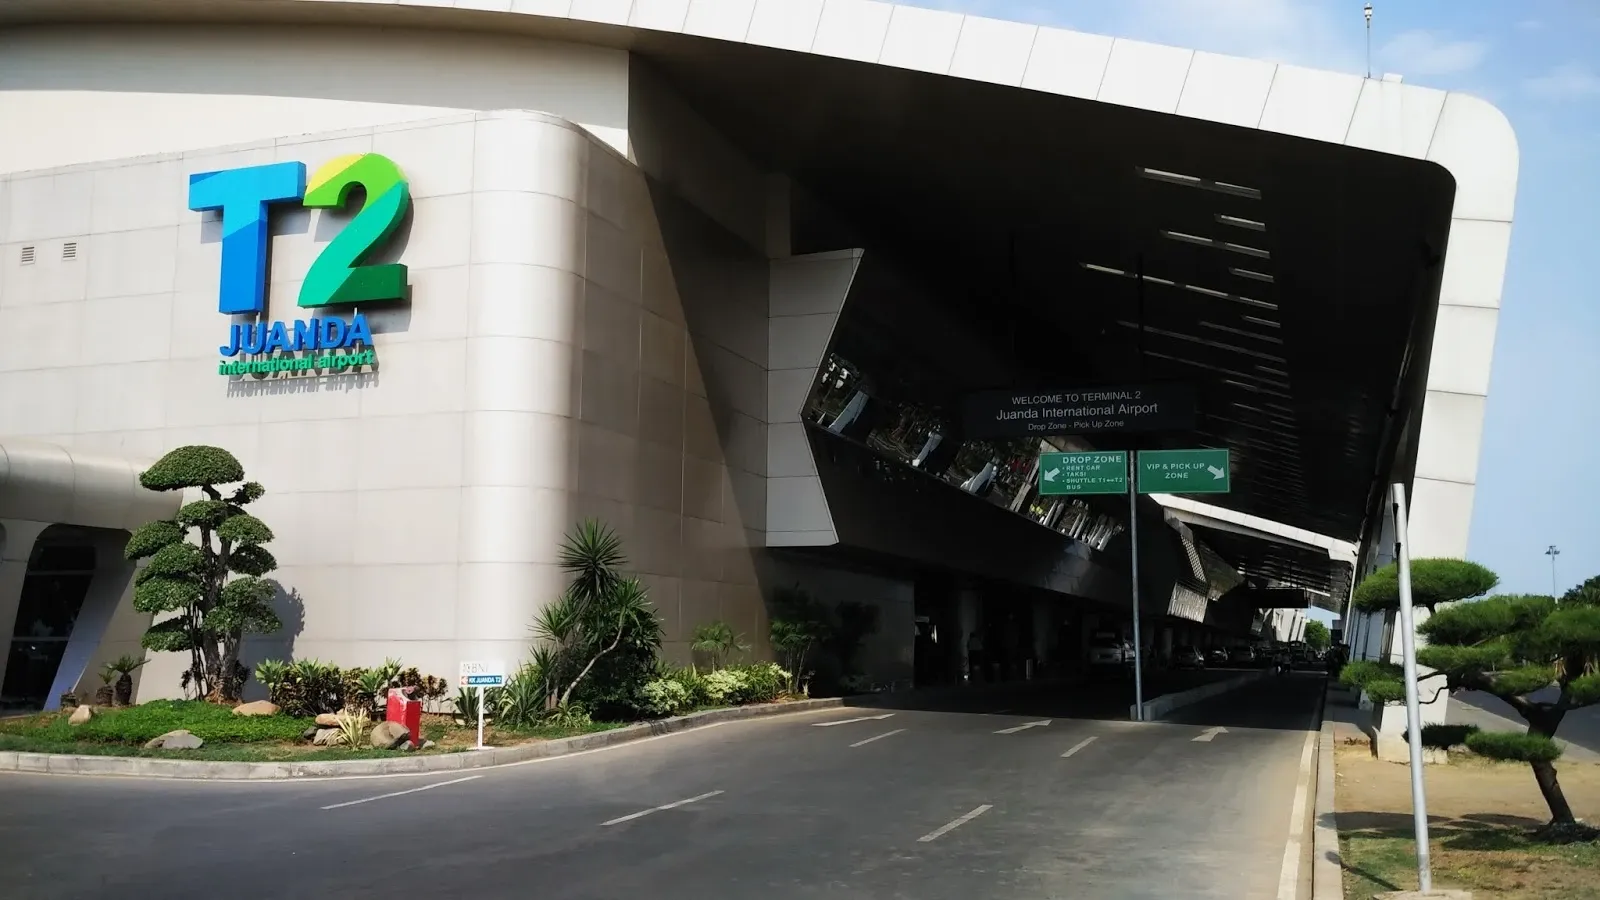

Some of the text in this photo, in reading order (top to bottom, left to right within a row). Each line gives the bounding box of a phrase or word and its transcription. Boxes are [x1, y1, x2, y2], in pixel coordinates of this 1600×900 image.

[189, 153, 408, 314] T2
[219, 312, 373, 357] JUANDA
[218, 349, 375, 376] international airport
[1012, 391, 1141, 405] WELCOME TO TERMINAL 2
[996, 403, 1159, 421] Juanda International Airport
[1028, 423, 1046, 432] Drop
[1048, 422, 1067, 430] Zone
[1074, 420, 1089, 429] Pick
[1090, 420, 1102, 429] Up
[1104, 419, 1125, 428] Zone
[1062, 455, 1122, 464] DROP ZONE
[1146, 463, 1161, 471] VIP
[1193, 462, 1205, 470] UP
